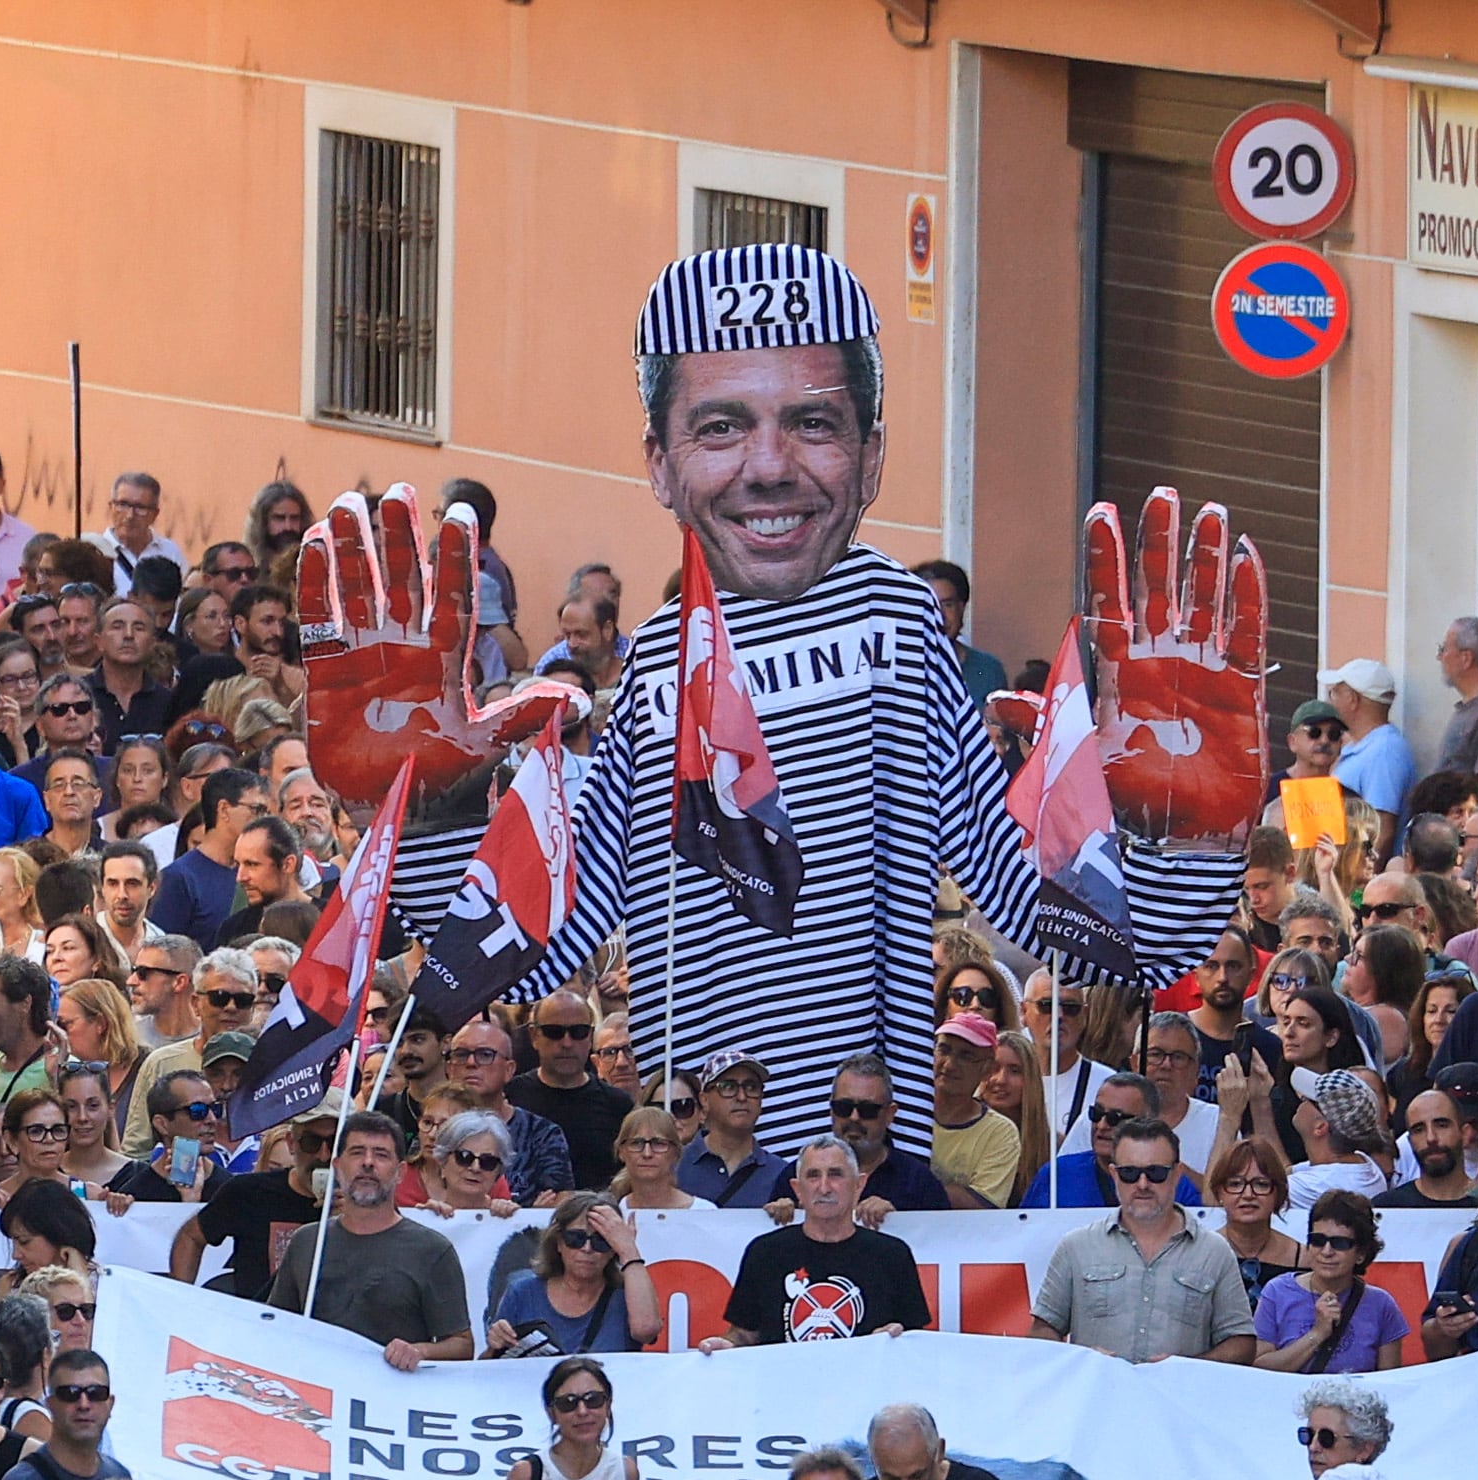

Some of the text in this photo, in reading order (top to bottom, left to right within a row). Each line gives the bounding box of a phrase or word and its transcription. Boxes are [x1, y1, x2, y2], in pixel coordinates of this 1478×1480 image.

[1248, 144, 1323, 199] 20
[716, 279, 810, 327] 228
[1257, 295, 1336, 317] SEMESTRE
[654, 632, 892, 707] CMINAL
[349, 1398, 523, 1441] LES
